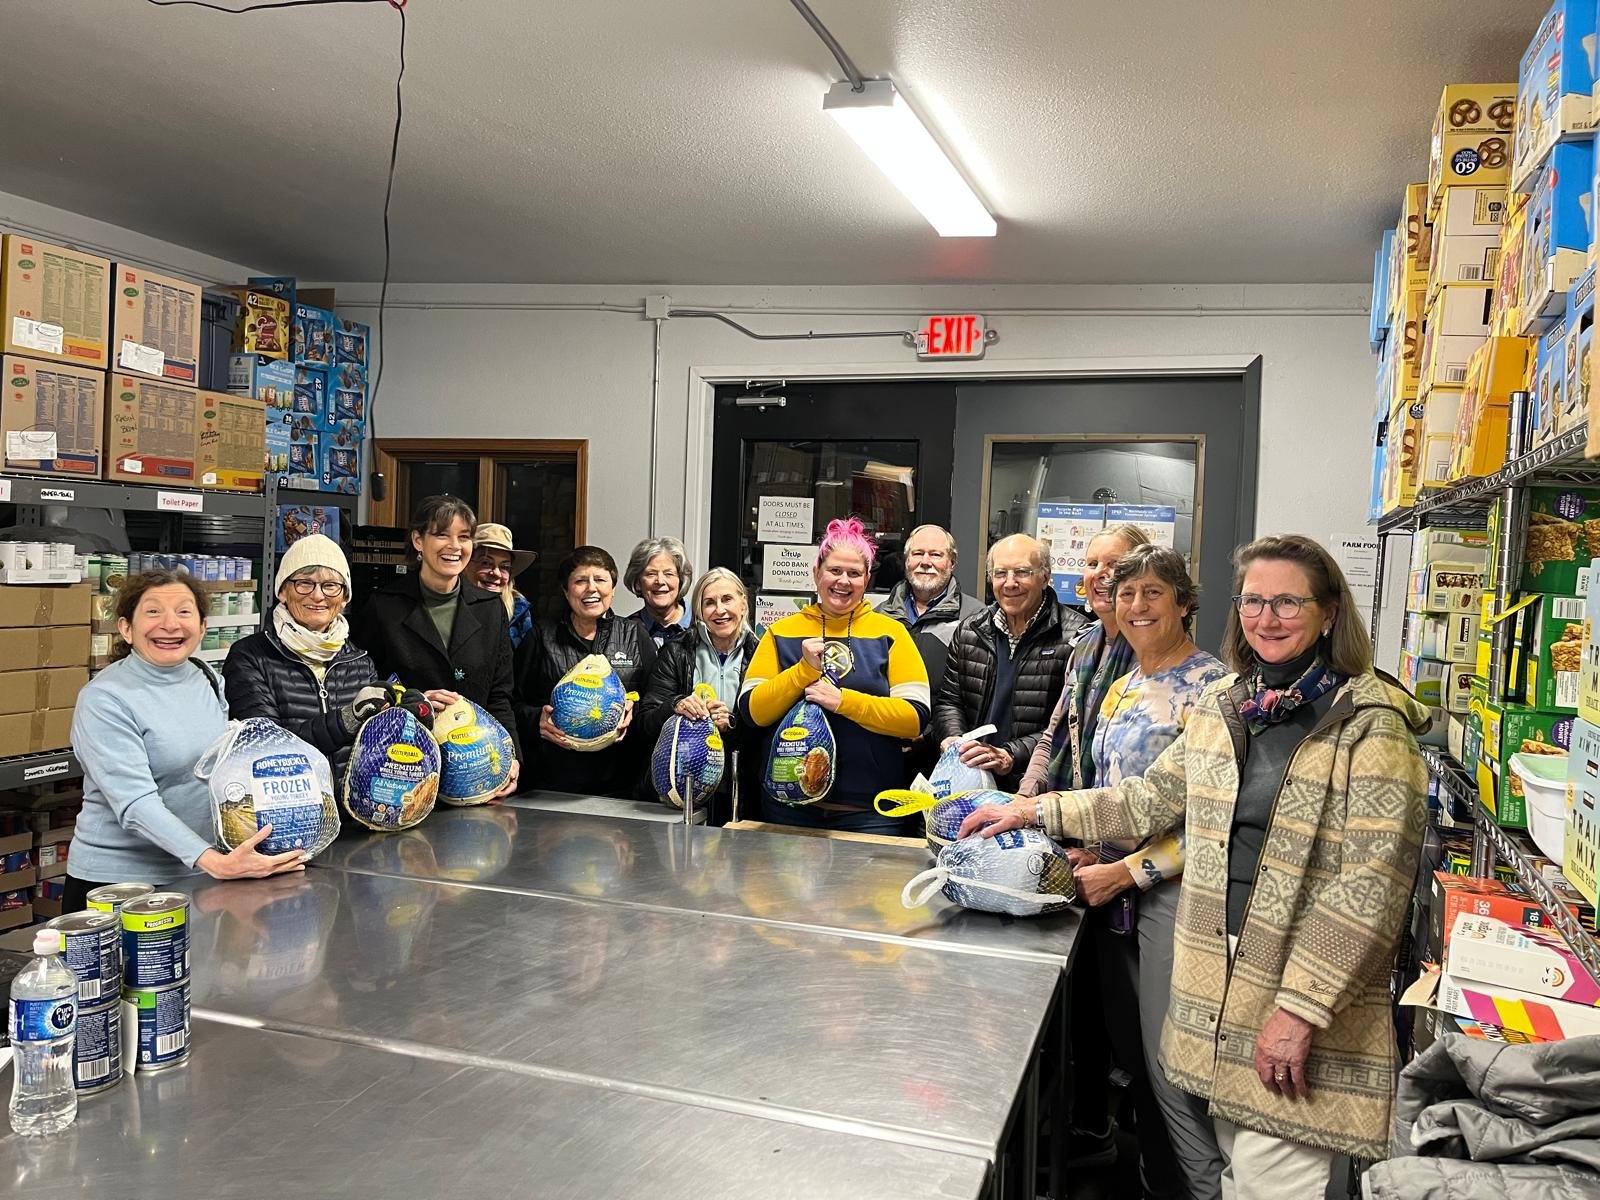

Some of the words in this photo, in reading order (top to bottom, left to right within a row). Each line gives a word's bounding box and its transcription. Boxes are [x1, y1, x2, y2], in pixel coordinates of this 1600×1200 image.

[1455, 161, 1475, 174] 60
[248, 294, 258, 306] 42
[297, 308, 306, 318] 42
[929, 316, 977, 354] EXIT
[316, 378, 322, 390] 42
[1412, 403, 1424, 412] 60
[329, 413, 335, 424] 42
[324, 473, 330, 483] 42
[163, 498, 180, 506] Toilet
[181, 500, 199, 508] Paper
[564, 687, 602, 701] Premium
[447, 741, 492, 763] Premium
[256, 757, 306, 770] HONEYSUCKLE
[384, 762, 422, 772] PREMIUM
[263, 779, 311, 795] FROZEN
[1577, 839, 1595, 874] MIX
[1479, 900, 1490, 915] 36
[1530, 911, 1539, 922] 18
[146, 917, 172, 928] PROGRESSO
[57, 1005, 71, 1015] Pure
[58, 1013, 71, 1024] Life
